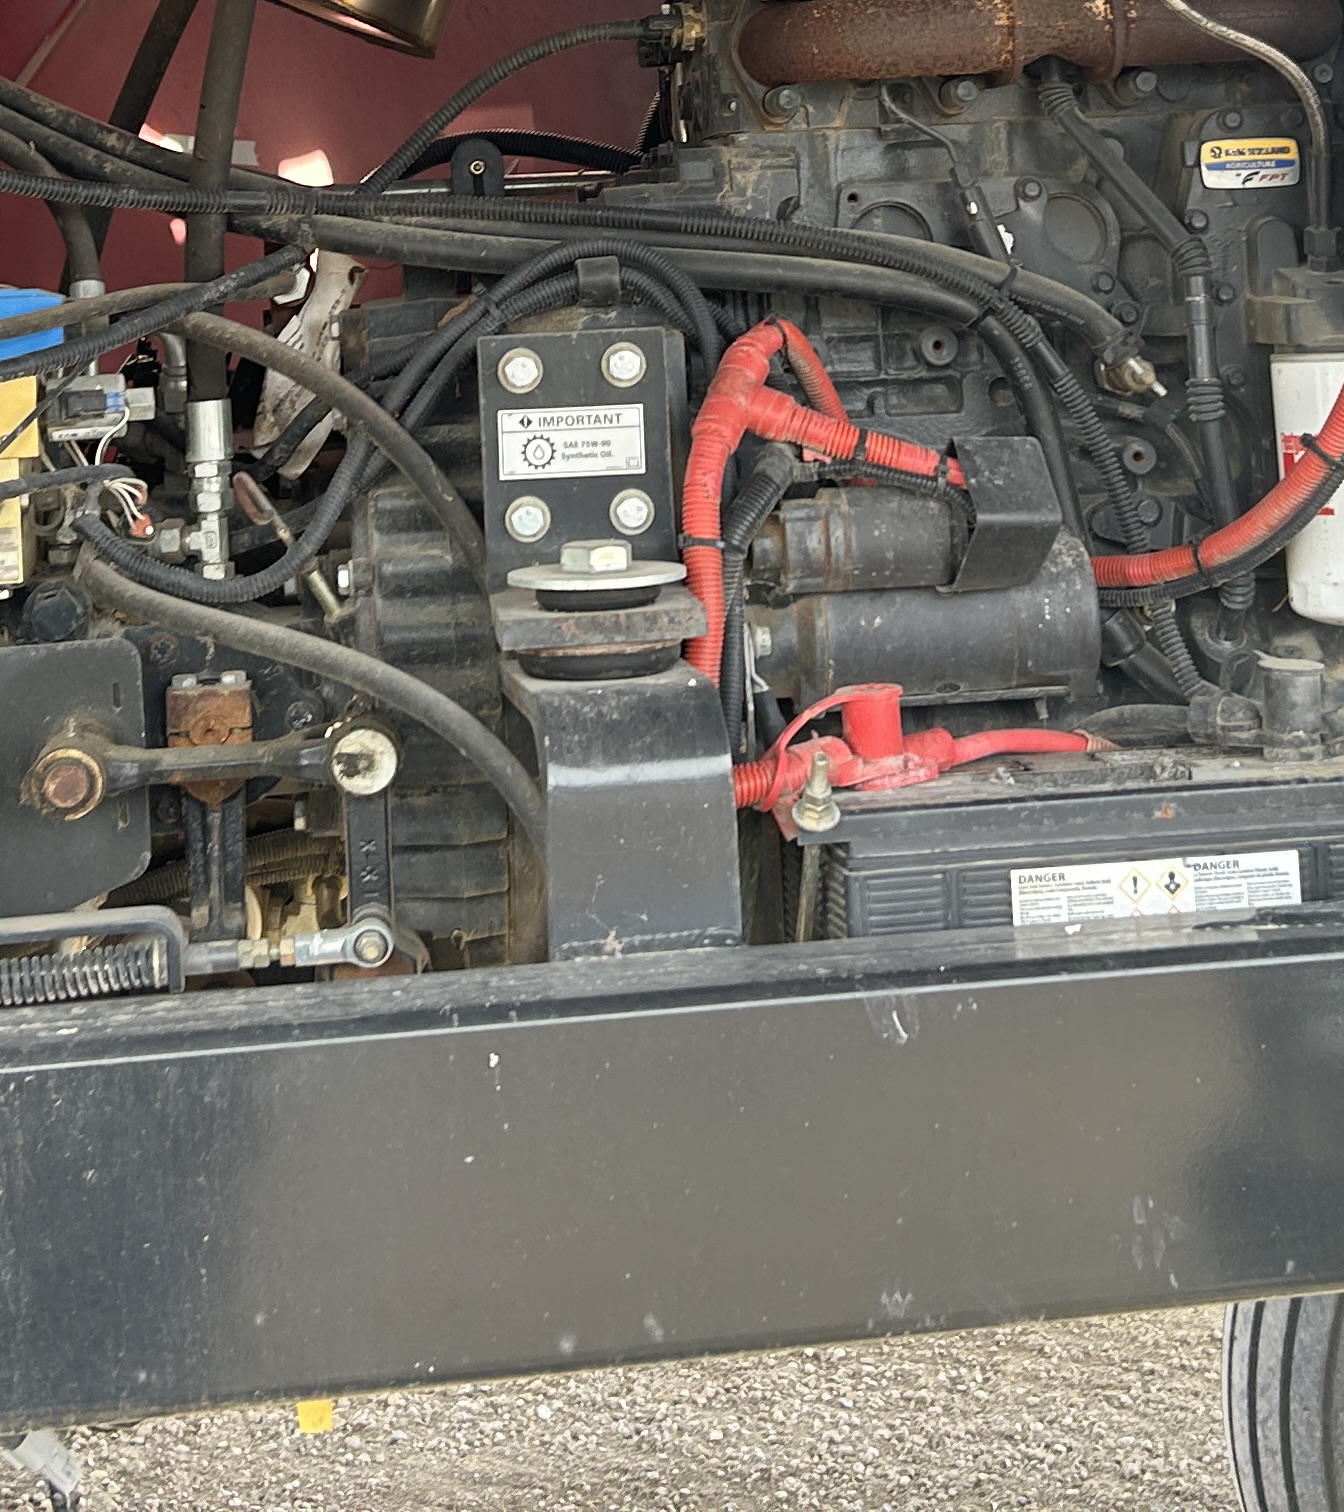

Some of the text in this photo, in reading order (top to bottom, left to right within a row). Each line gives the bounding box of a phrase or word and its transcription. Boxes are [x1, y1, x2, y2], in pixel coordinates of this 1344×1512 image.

[538, 412, 623, 428] IMPORTANT
[563, 440, 579, 449] SAE
[561, 451, 598, 461] Synthetic
[1193, 859, 1240, 871] DANGER
[1018, 872, 1066, 885] DANGER
